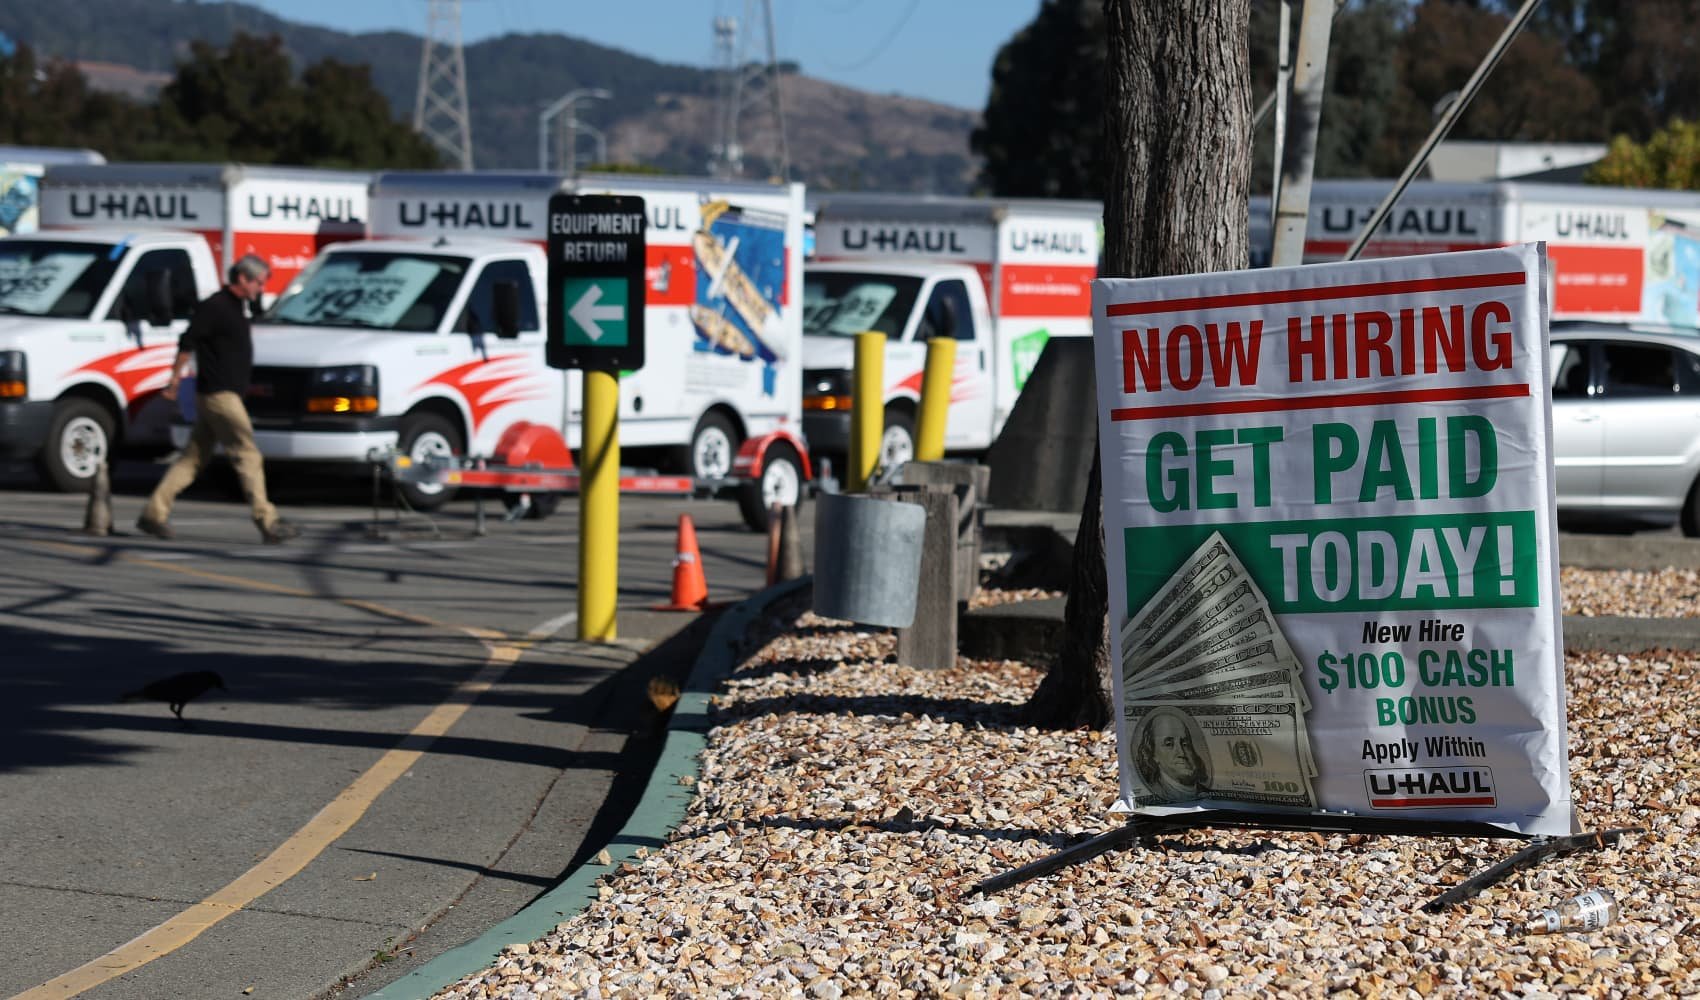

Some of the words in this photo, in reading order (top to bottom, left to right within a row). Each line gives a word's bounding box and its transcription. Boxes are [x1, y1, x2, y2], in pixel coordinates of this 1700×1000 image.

[71, 194, 198, 220] U-HAUL
[249, 195, 362, 222] U-HAUL
[399, 202, 532, 229] U-HAUL
[552, 213, 643, 235] EQUIPMENT
[1556, 212, 1630, 239] U-HAUL
[564, 241, 628, 262] RETURN
[842, 227, 965, 252] U-HAUL
[1011, 231, 1087, 254] U-HAUL
[1121, 320, 1264, 394] NOW
[1287, 301, 1513, 383] HIRING
[1145, 426, 1284, 513] GET
[1312, 415, 1499, 505] PAID
[1270, 525, 1516, 603] TODAY!
[1362, 621, 1411, 643] New
[1418, 619, 1465, 642] Hire
[1317, 650, 1406, 694] $100
[1418, 649, 1515, 687] CASH
[1376, 696, 1477, 726] BONUS
[1361, 738, 1419, 763] Apply
[1425, 736, 1486, 758] Within
